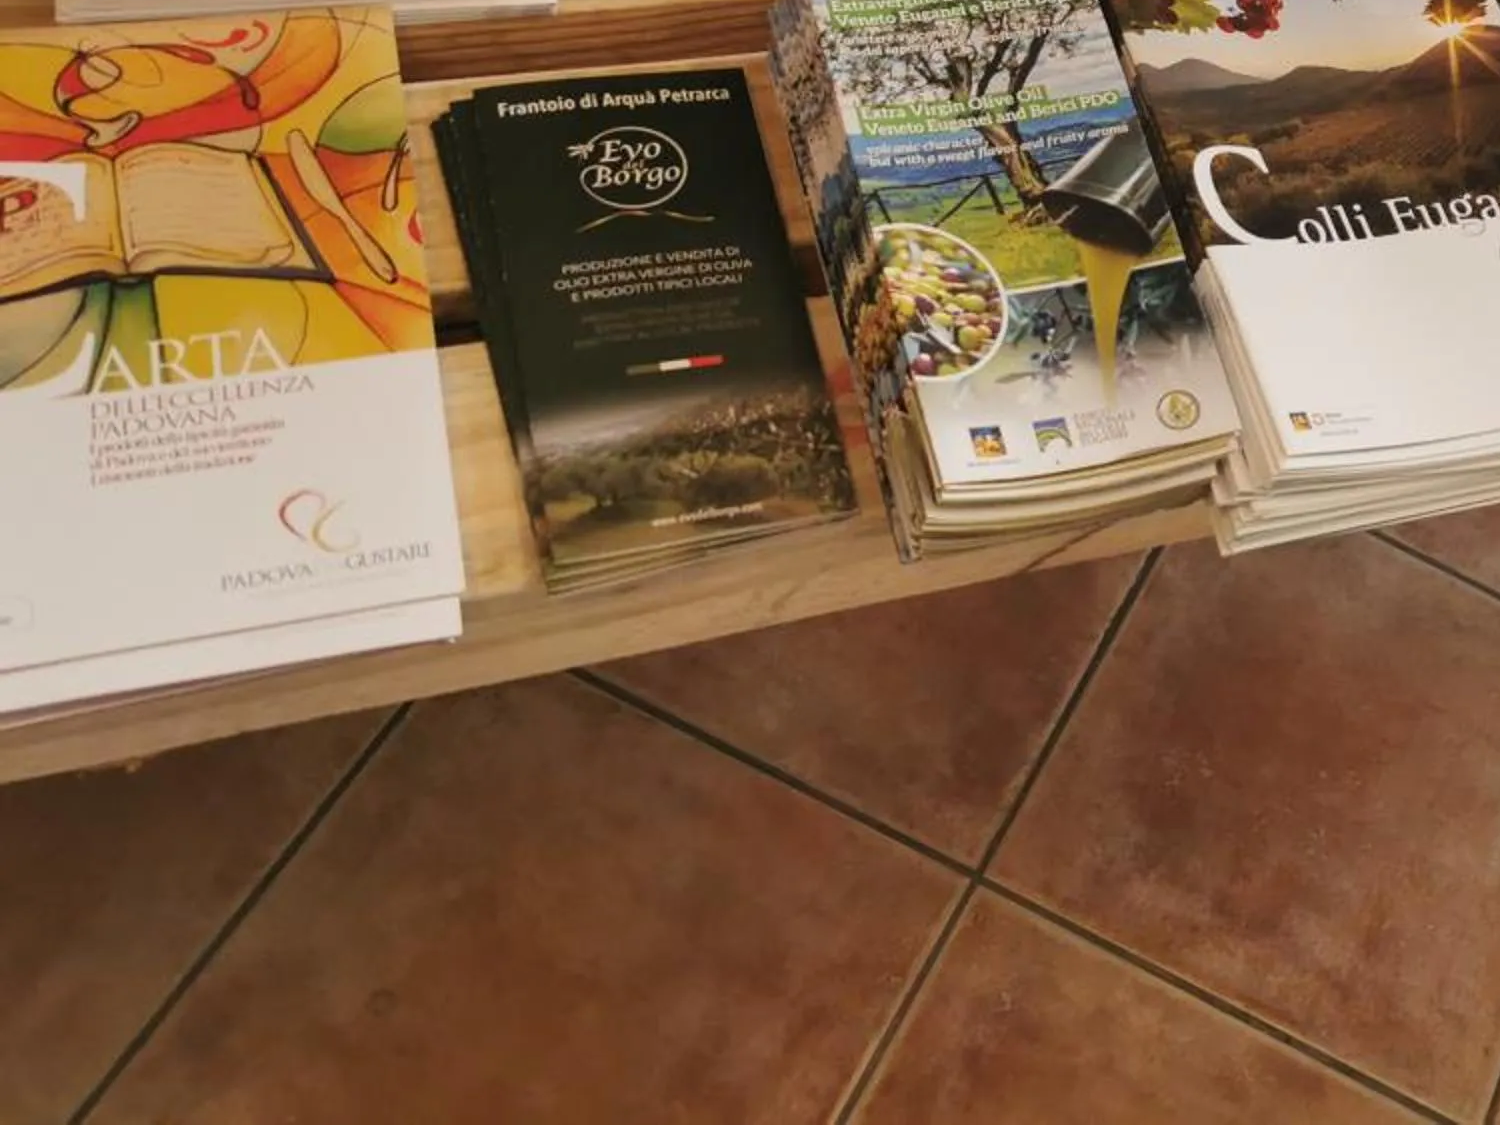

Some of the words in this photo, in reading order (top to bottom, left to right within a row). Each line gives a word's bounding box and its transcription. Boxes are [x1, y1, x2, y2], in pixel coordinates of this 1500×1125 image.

[835, 12, 897, 28] Veneto
[900, 3, 968, 23] Euganei
[970, 5, 980, 16] e
[497, 94, 576, 117] Frantoio
[580, 92, 599, 109] di
[603, 89, 655, 111] Arquà
[660, 86, 731, 104] Petrarca
[861, 104, 906, 121] Extra
[910, 100, 964, 118] Virgin
[968, 92, 1013, 111] Olive
[1016, 86, 1043, 103] Oil
[863, 121, 924, 137] Veneto
[927, 114, 993, 134] Euganei
[1031, 98, 1077, 119] Berici
[1080, 91, 1119, 109] PDO
[600, 139, 661, 163] Evo
[894, 151, 926, 166] with
[592, 164, 681, 190] Borgo
[1192, 144, 1377, 245] Colli
[553, 276, 589, 291] OLIO
[592, 269, 636, 286] EXTRA
[638, 264, 695, 280] VERGINE
[713, 259, 753, 272] OLIVA
[561, 254, 650, 275] PRODUZIONE
[666, 249, 723, 263] VENDITA
[583, 281, 655, 300] PRODOTTI
[696, 274, 744, 288] LOCALI
[91, 405, 237, 440] PADOVANA
[221, 562, 313, 592] PADOVA
